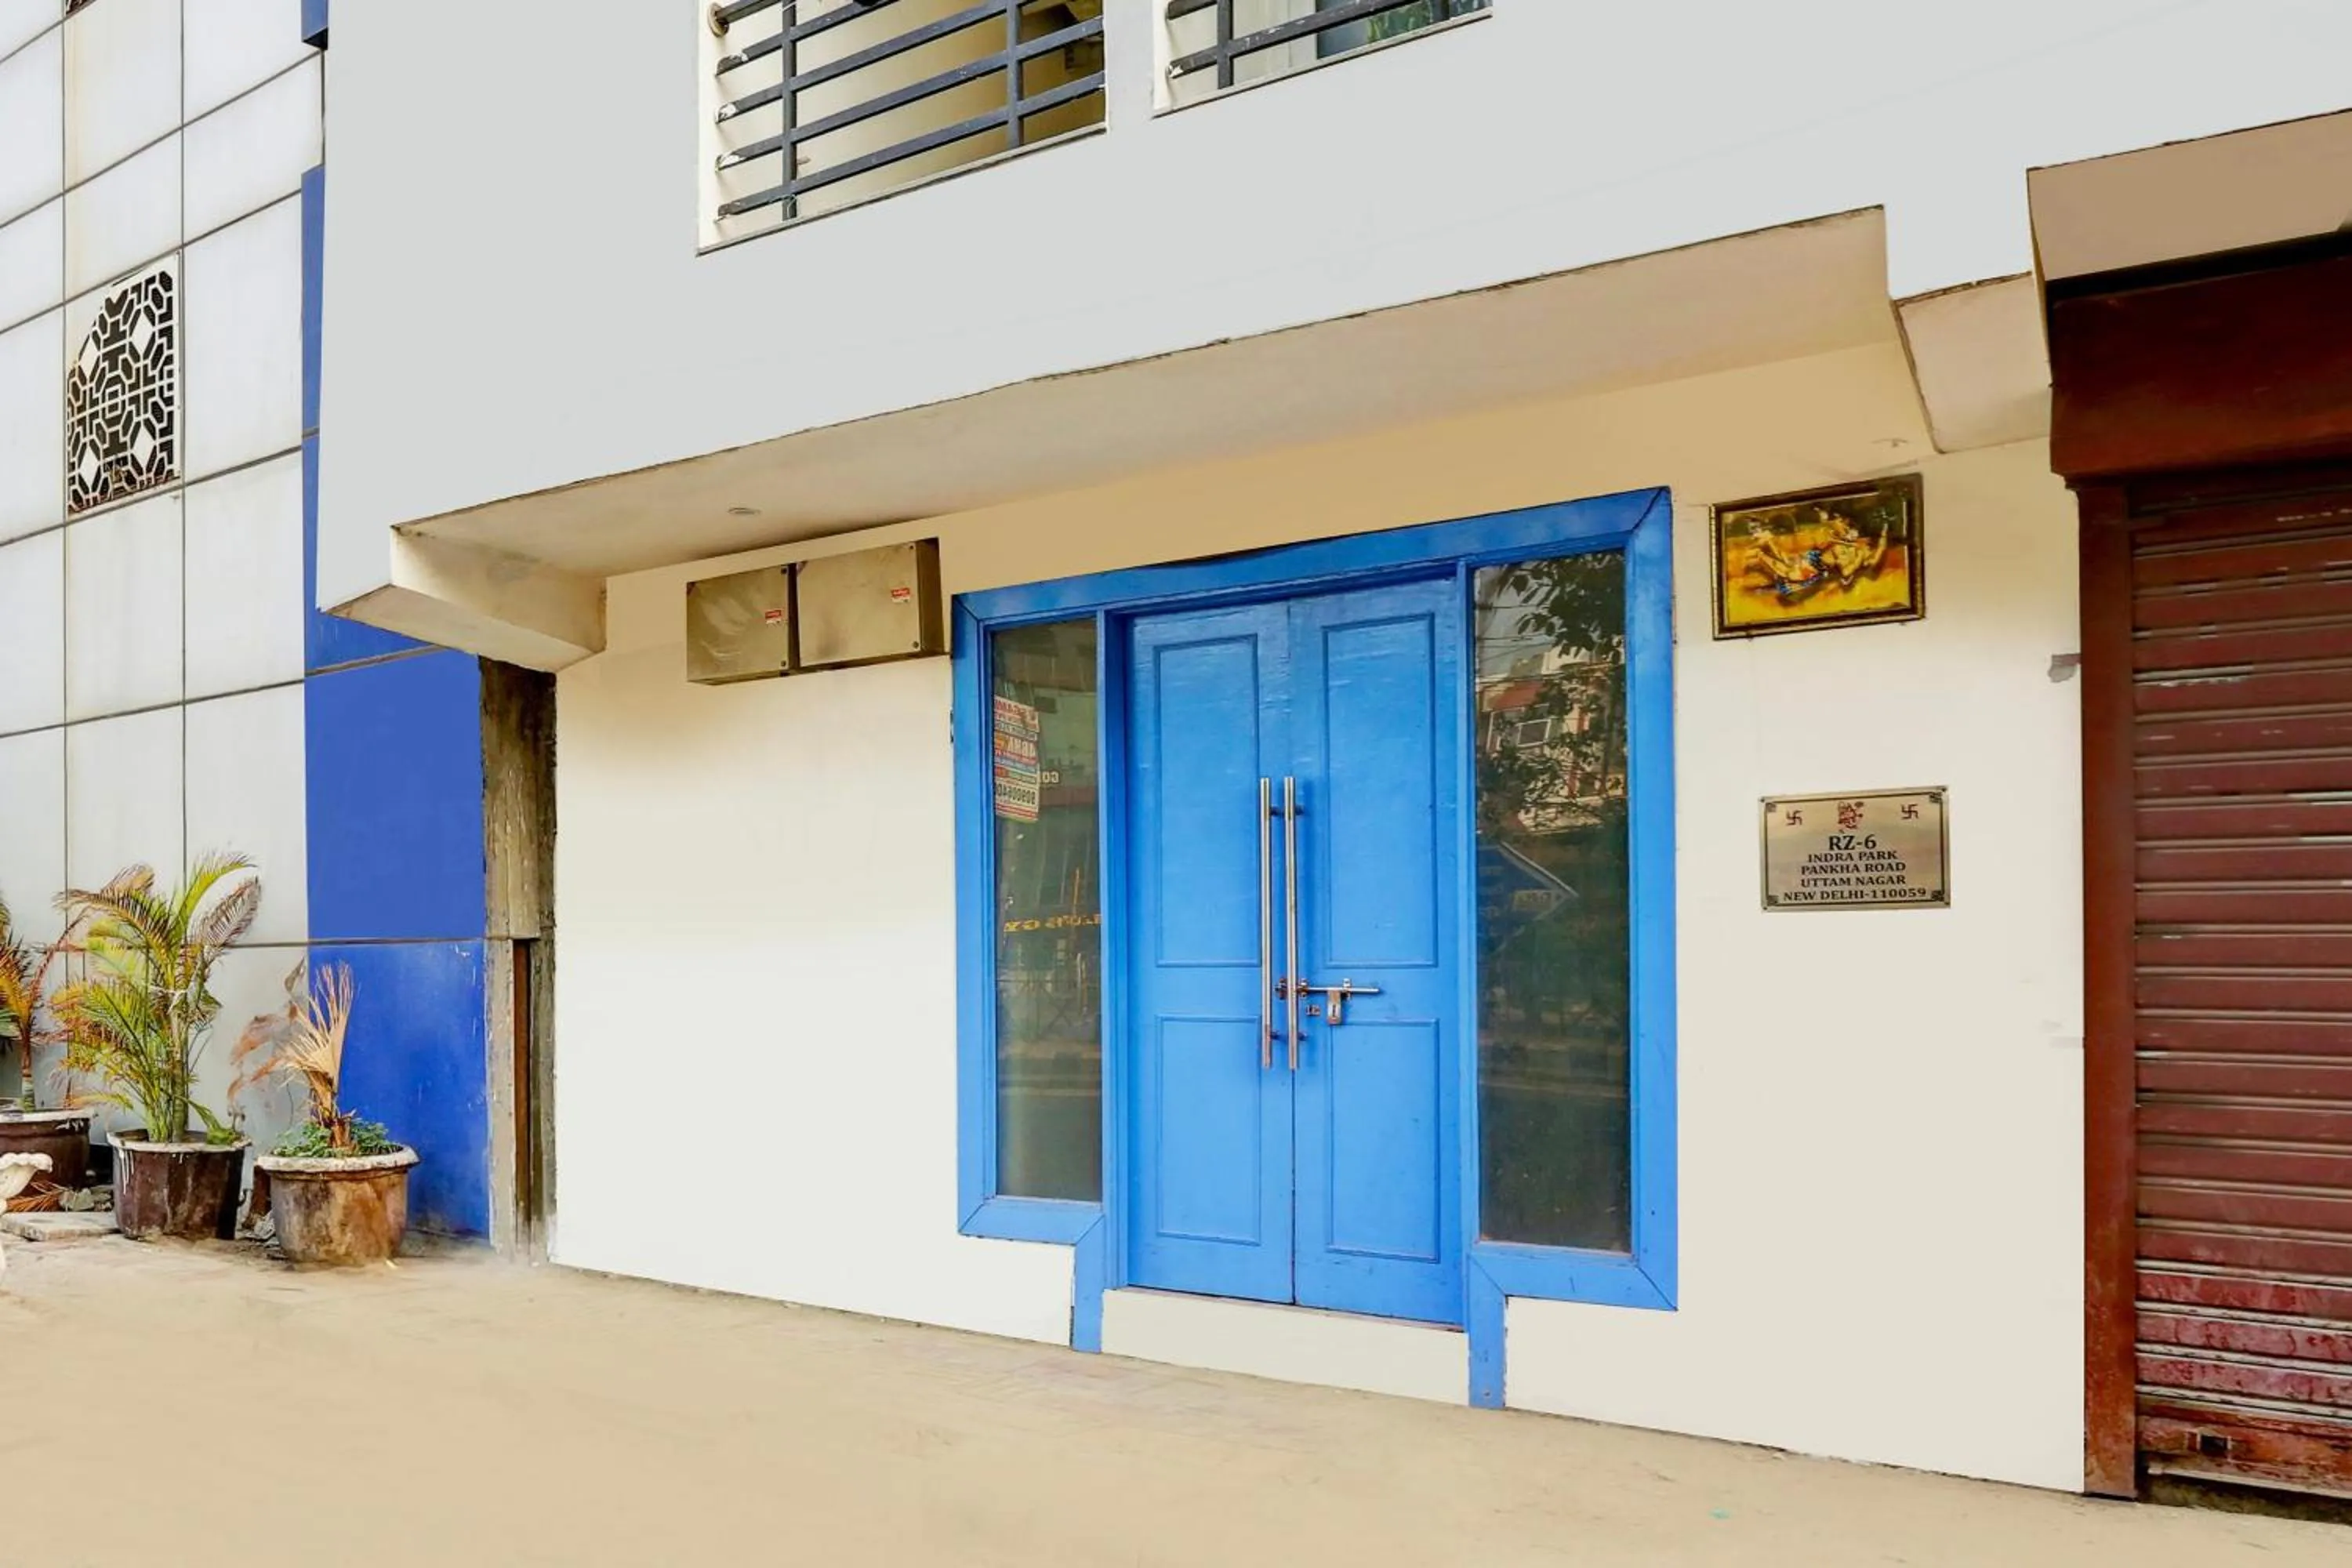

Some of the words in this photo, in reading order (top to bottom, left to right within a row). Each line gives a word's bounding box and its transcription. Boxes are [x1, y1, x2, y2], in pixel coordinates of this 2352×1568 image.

[1828, 834, 1877, 851] RZ-6
[1809, 853, 1853, 863] INDRA
[1858, 851, 1898, 861] PARK
[1801, 863, 1862, 875] PANKHA
[1865, 862, 1906, 873] ROAD
[1801, 877, 1851, 887] UTTAM
[1856, 875, 1906, 886] NAGAR
[1784, 891, 1817, 901] NEW
[1820, 887, 1926, 900] DELHI-110059
